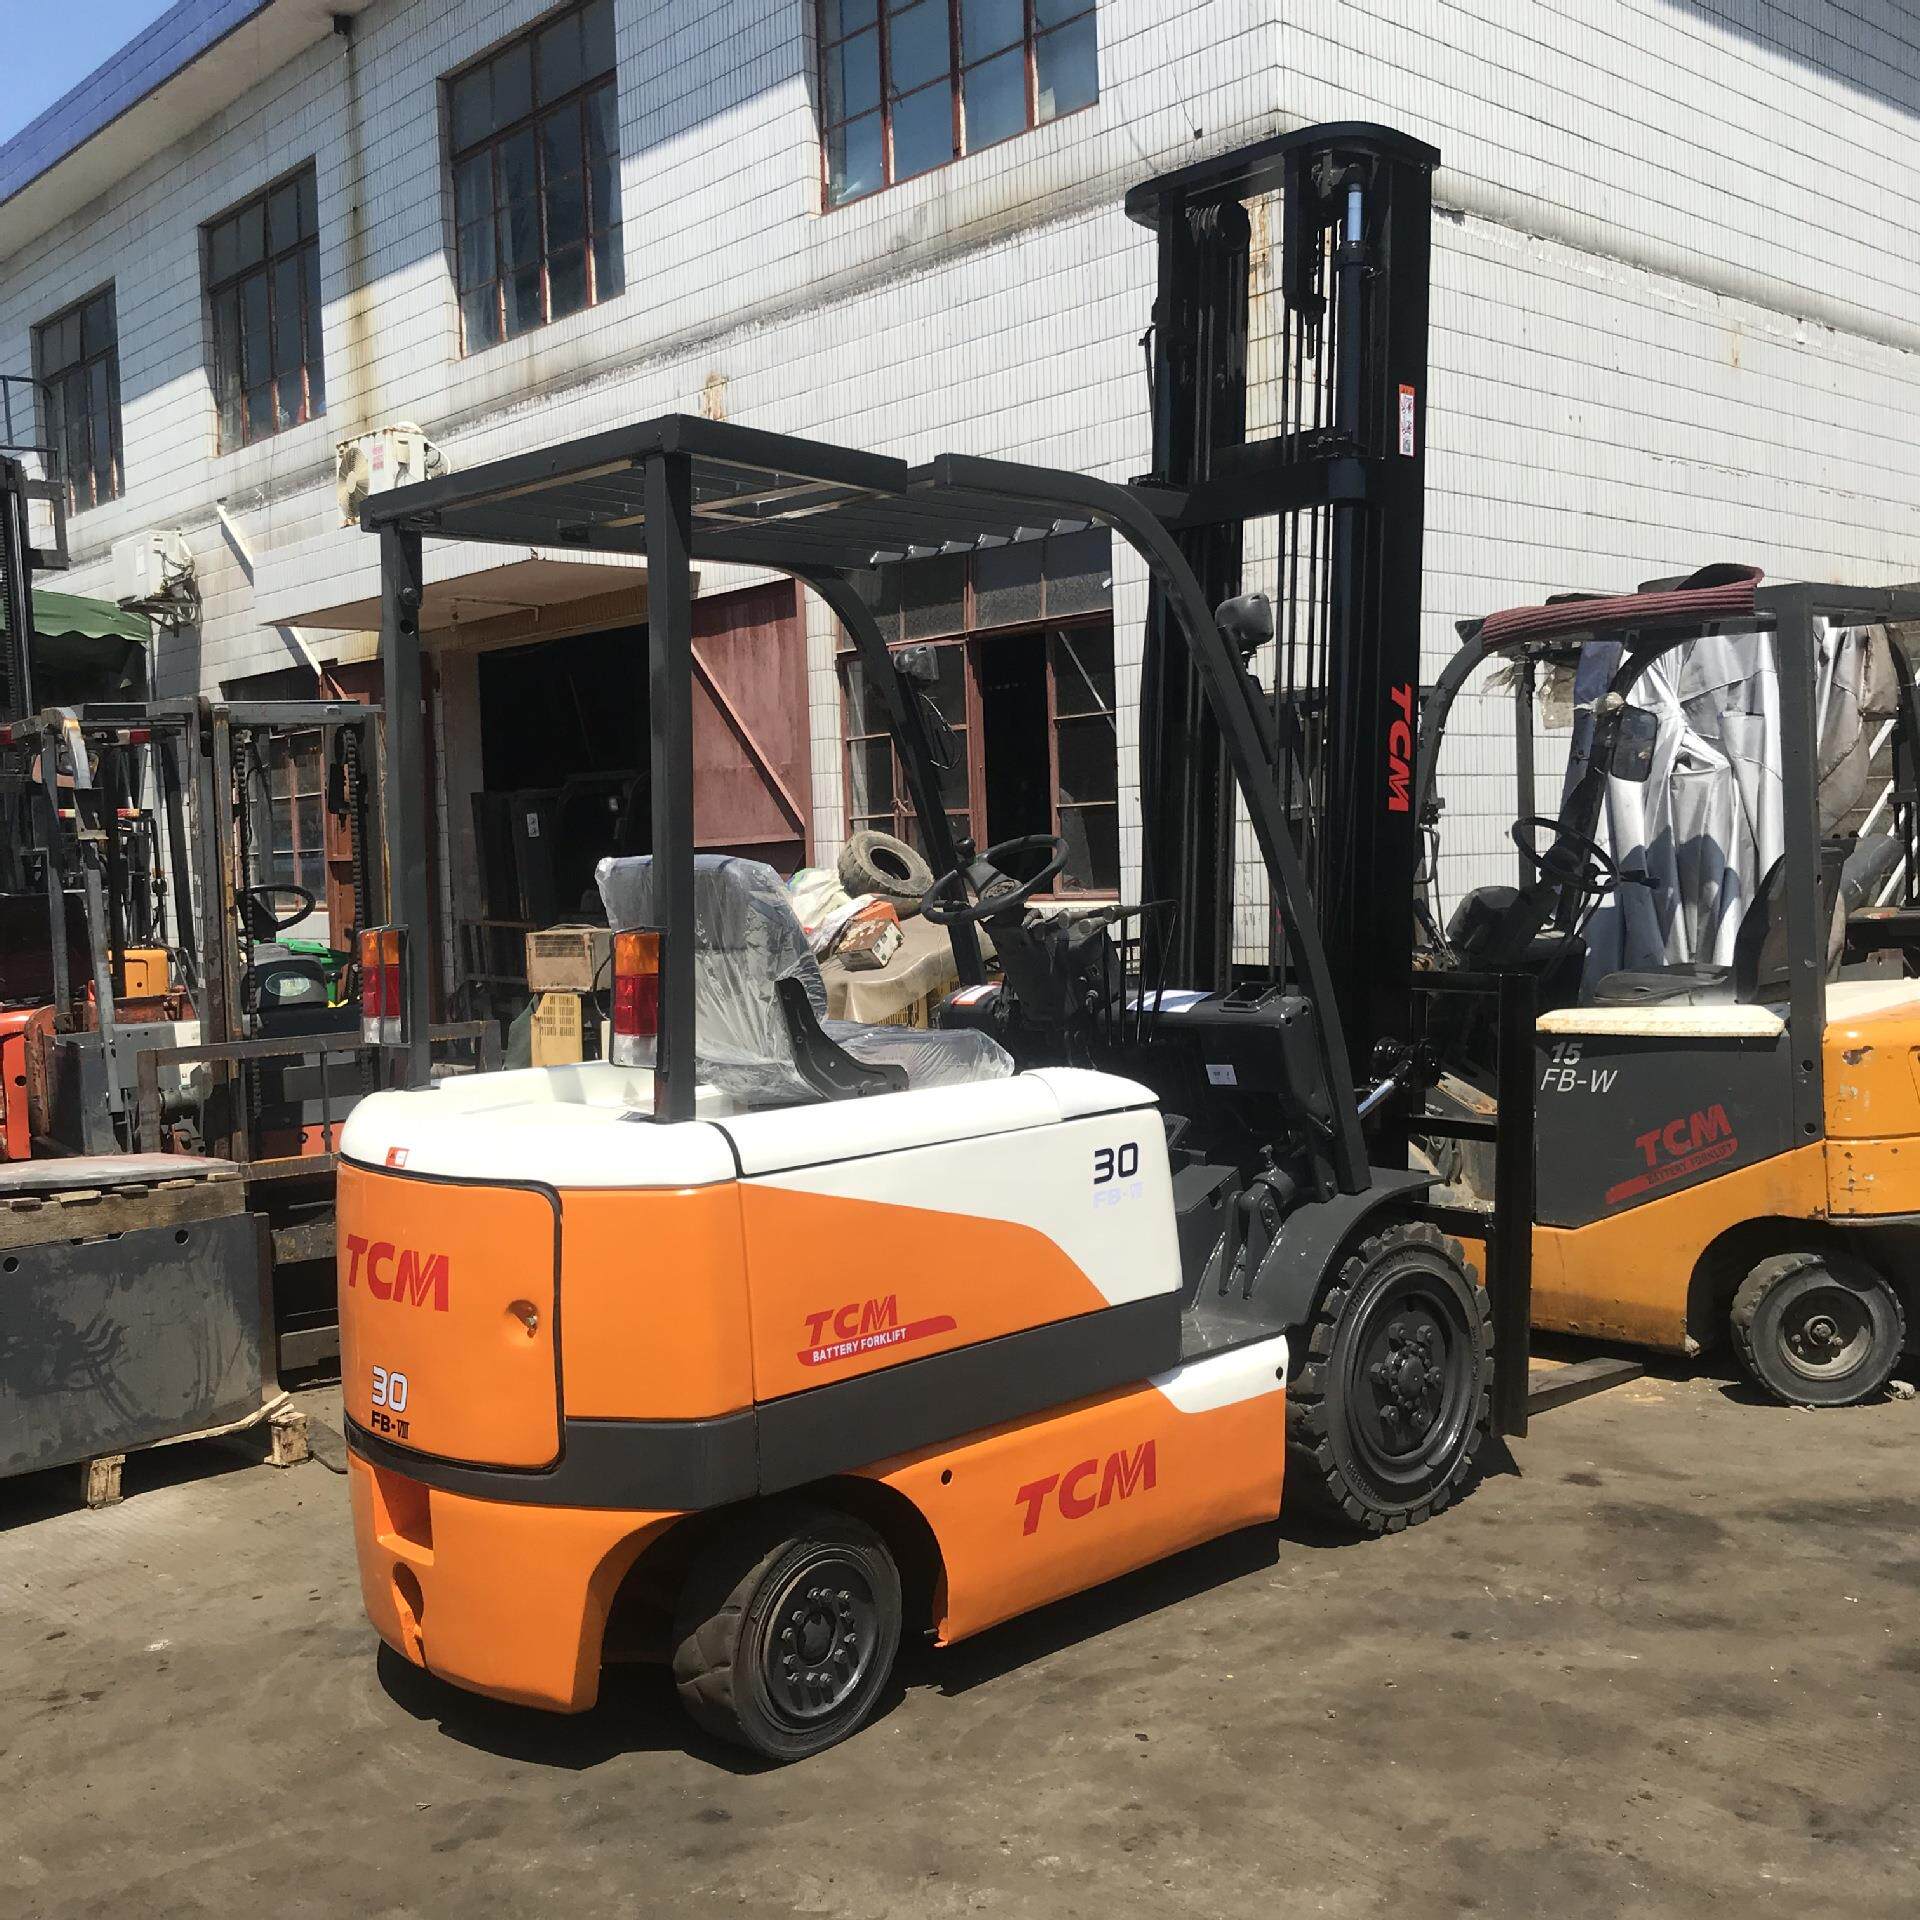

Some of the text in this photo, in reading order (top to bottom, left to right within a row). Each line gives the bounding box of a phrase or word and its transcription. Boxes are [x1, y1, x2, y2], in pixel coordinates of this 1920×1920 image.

[1388, 683, 1413, 812] TCM
[1551, 1042, 1584, 1065] 15
[1540, 1068, 1619, 1093] FB-W
[1635, 1103, 1732, 1167] TCM
[1094, 1142, 1138, 1184] 30
[346, 1233, 449, 1312] TCM
[804, 1294, 898, 1347] TCM
[813, 1328, 907, 1362] BATTERY FORKLIFT
[372, 1365, 409, 1413] 30
[1014, 1439, 1157, 1537] TCM
